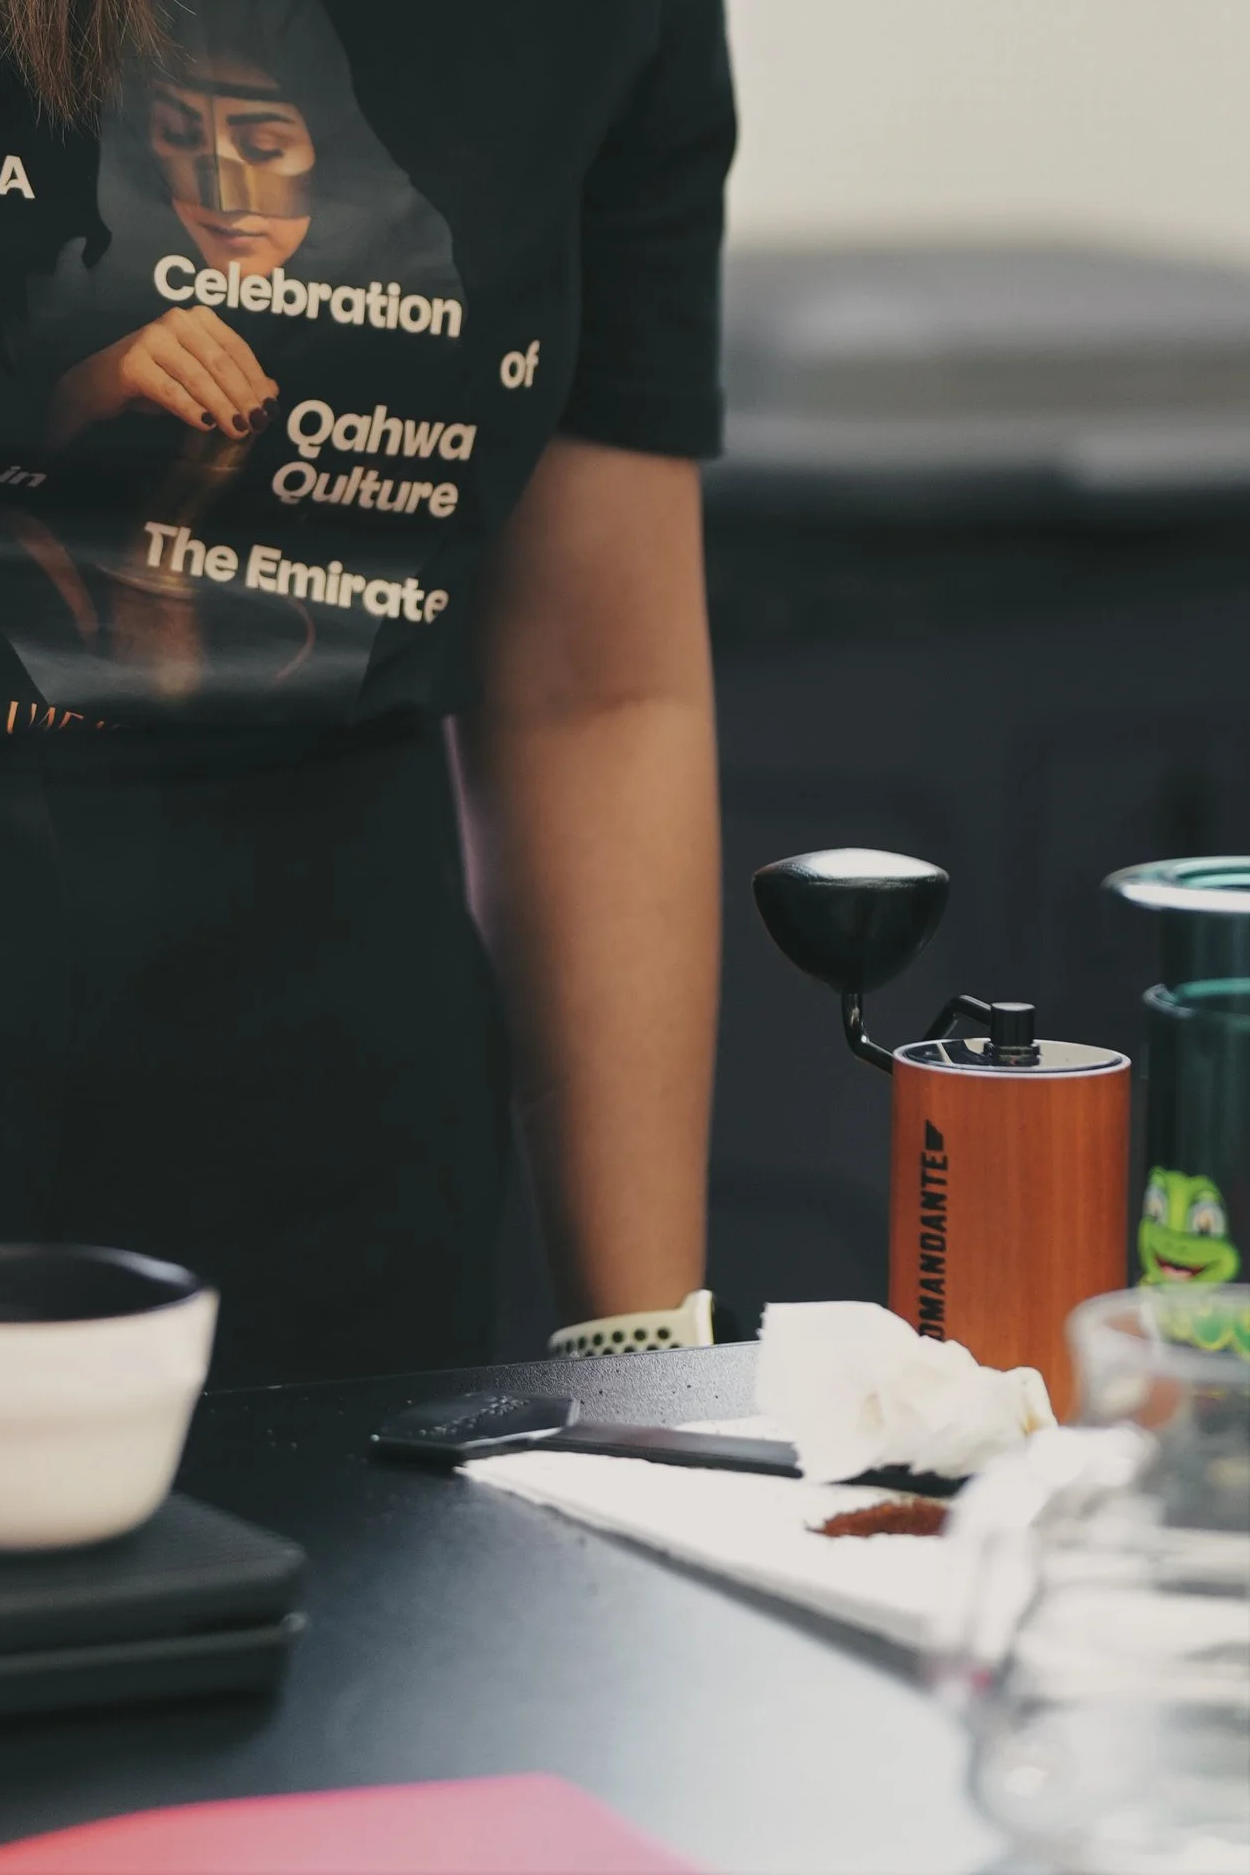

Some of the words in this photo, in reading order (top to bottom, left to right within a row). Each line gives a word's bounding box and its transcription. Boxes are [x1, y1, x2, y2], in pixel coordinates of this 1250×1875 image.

[153, 254, 463, 338] Celebration
[500, 340, 540, 389] of
[287, 399, 478, 460] Qahwa
[272, 461, 459, 518] Qulture
[144, 522, 238, 581] The
[245, 544, 450, 624] Emirate
[919, 1151, 948, 1342] OMANDANTE
